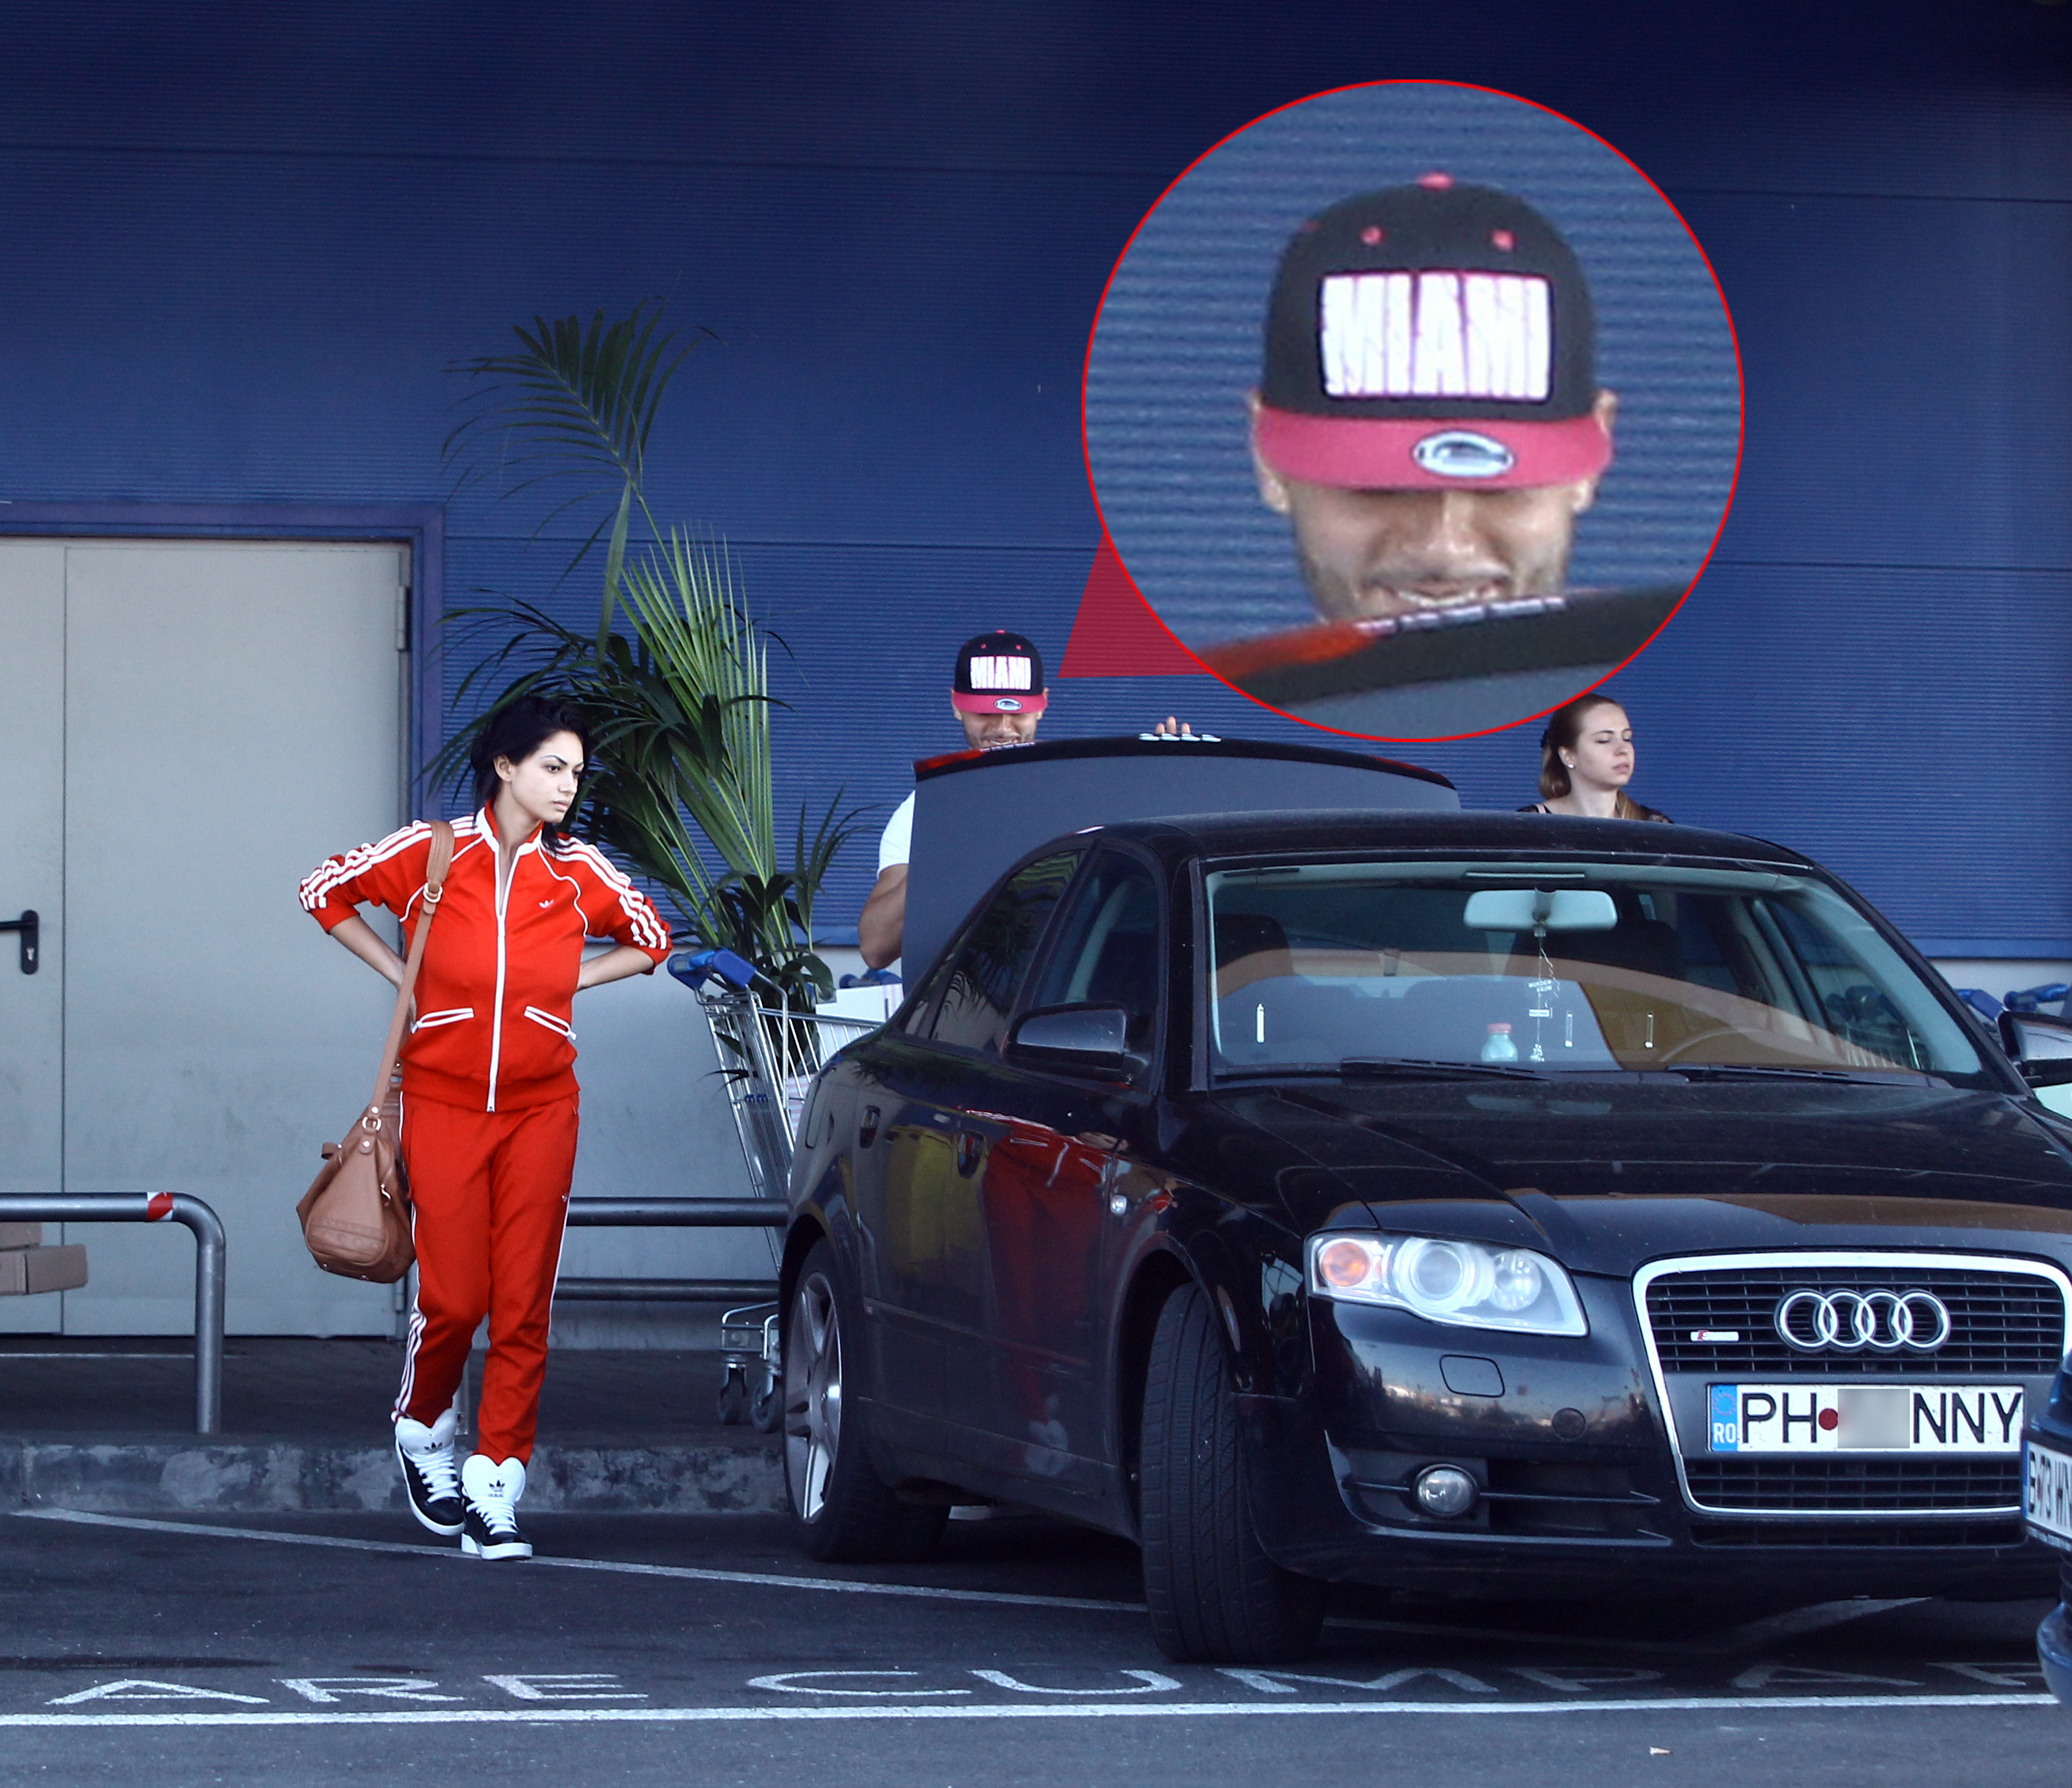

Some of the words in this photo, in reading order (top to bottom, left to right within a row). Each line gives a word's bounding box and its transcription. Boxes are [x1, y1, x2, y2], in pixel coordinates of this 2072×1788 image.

[1322, 270, 1551, 400] MIAMI
[970, 655, 1031, 690] MIAMI
[1713, 1423, 1736, 1444] RO
[1742, 1392, 1817, 1444] PH
[1913, 1392, 2022, 1443] NNY
[43, 1673, 649, 1705] ARE
